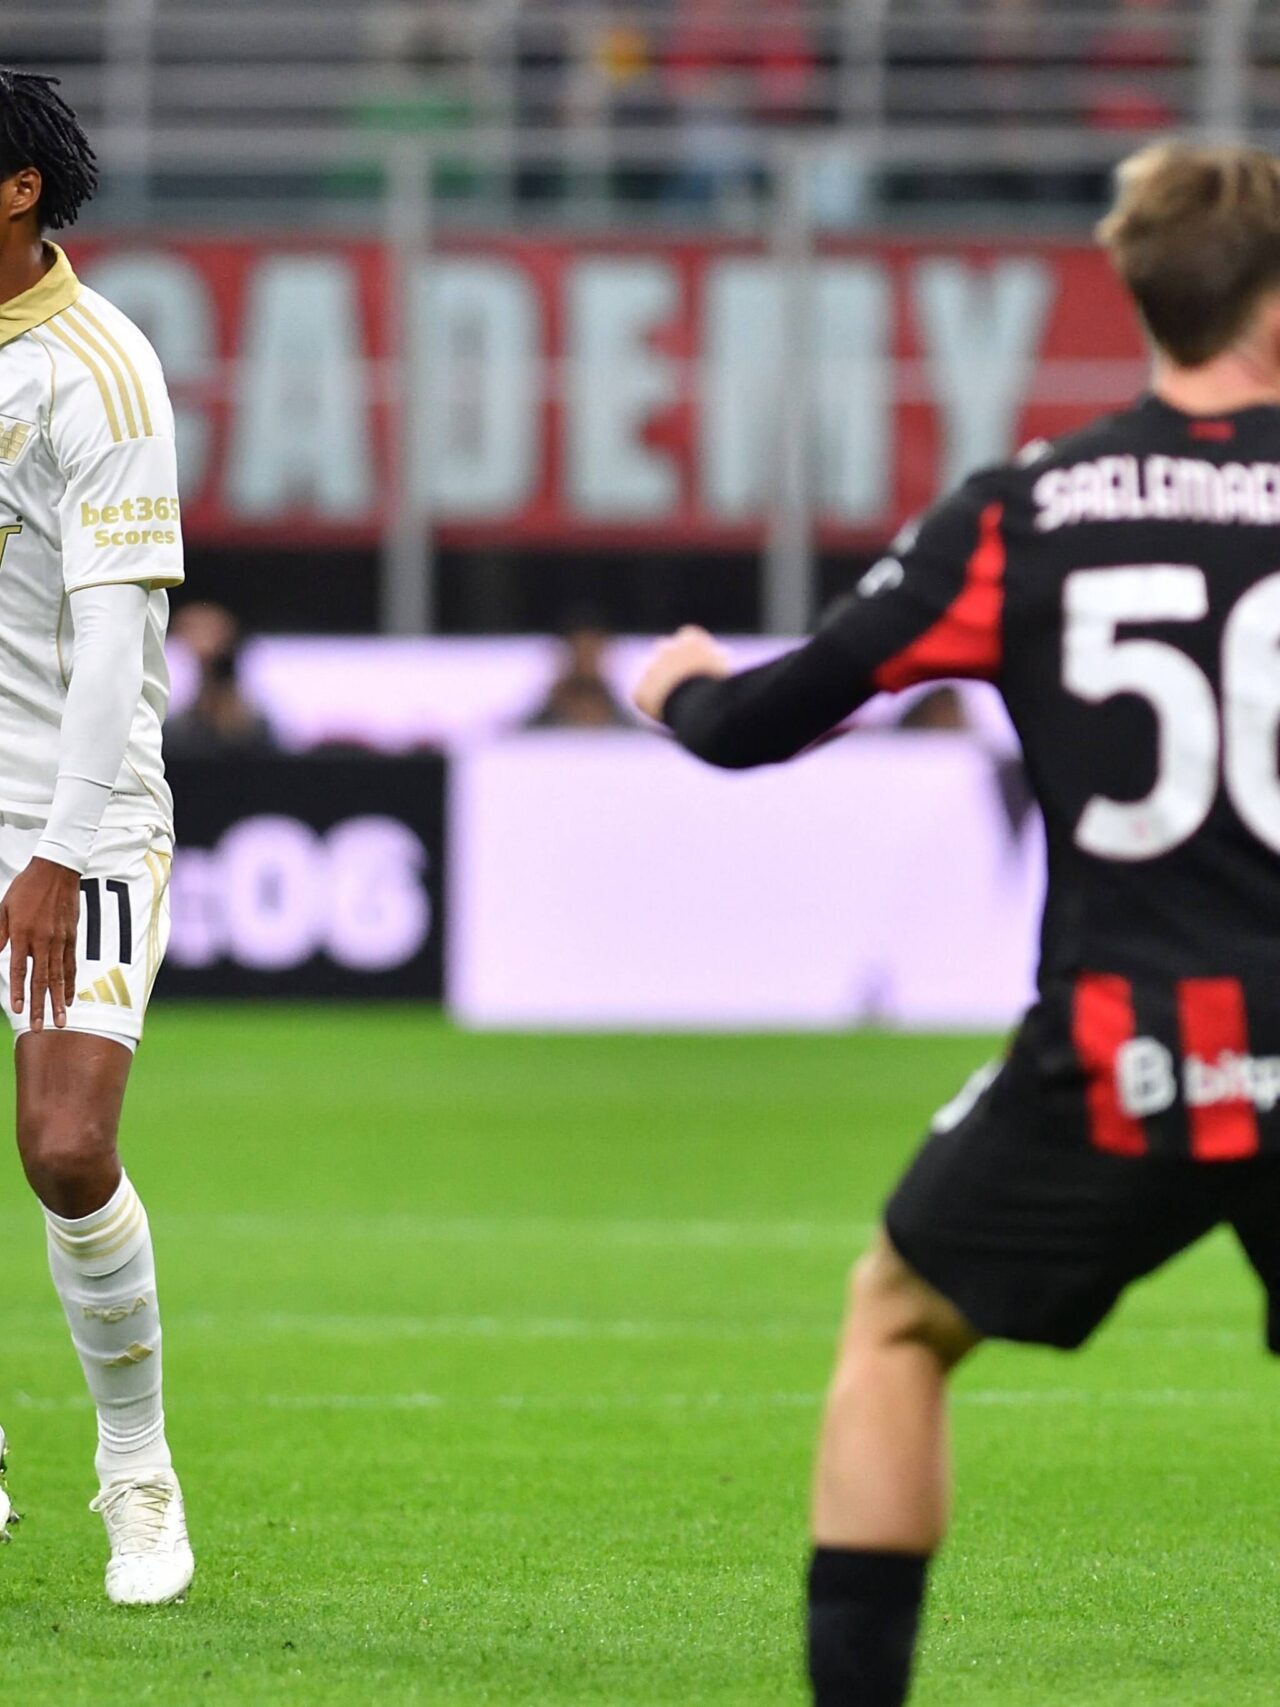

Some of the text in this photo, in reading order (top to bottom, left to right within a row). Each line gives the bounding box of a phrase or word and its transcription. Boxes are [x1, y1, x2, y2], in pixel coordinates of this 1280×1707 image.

[86, 250, 1056, 526] CADEMY
[81, 496, 179, 528] bet365
[94, 529, 176, 549] Scores
[80, 877, 132, 965] 11
